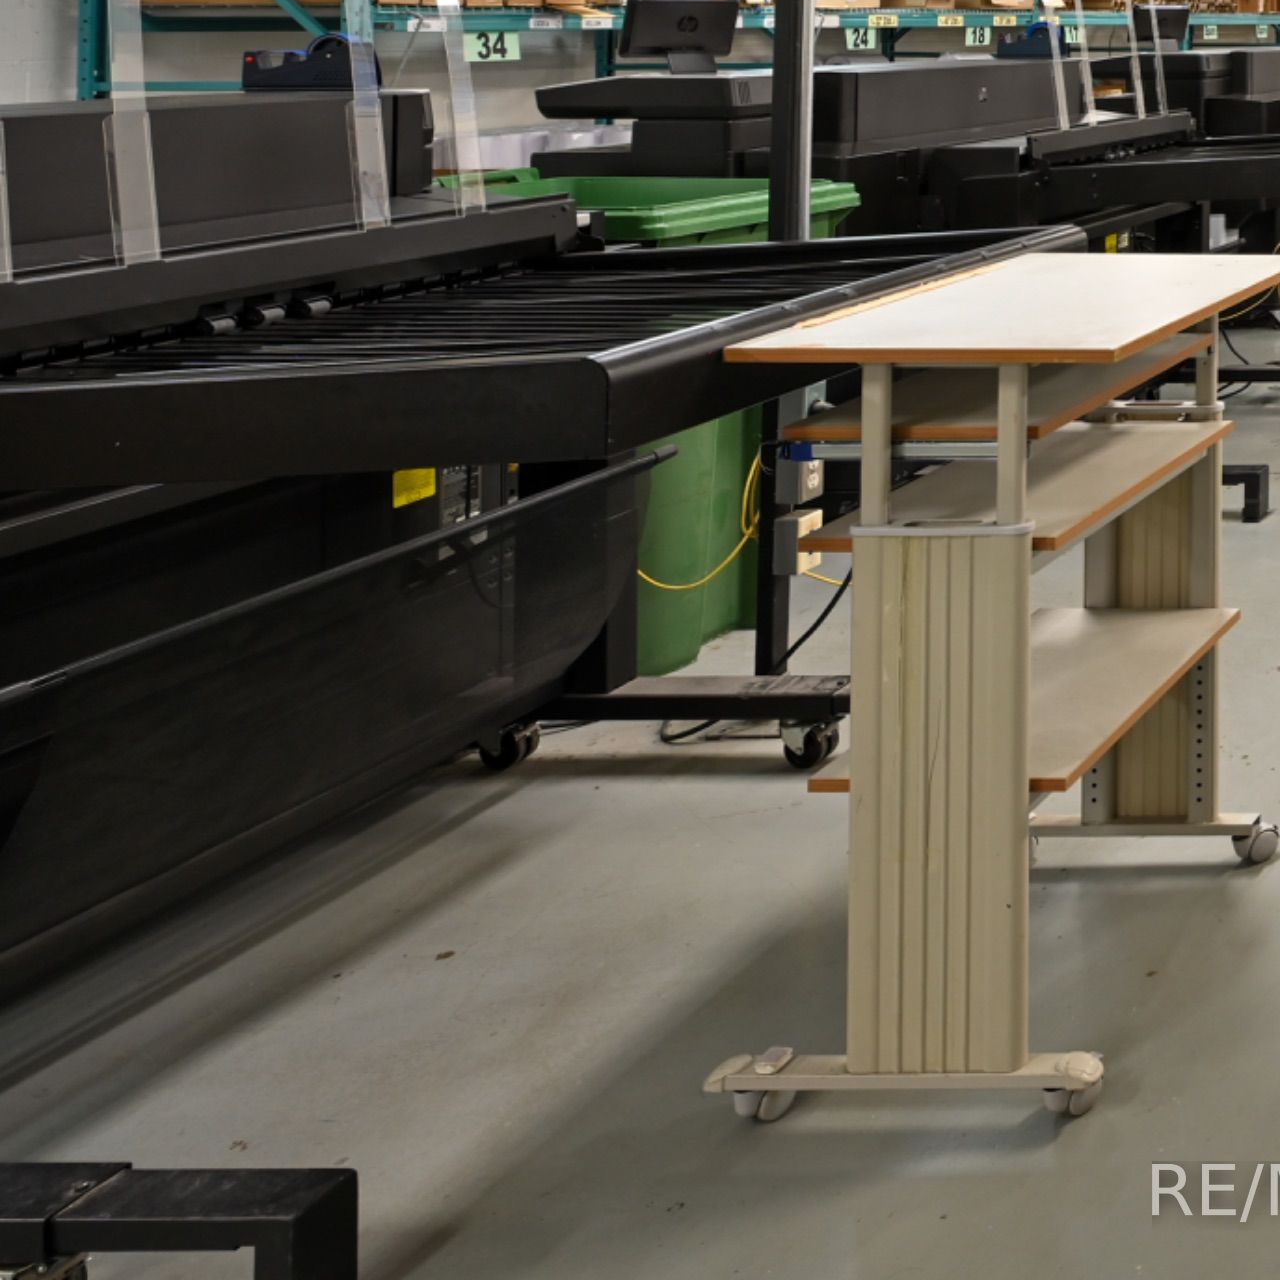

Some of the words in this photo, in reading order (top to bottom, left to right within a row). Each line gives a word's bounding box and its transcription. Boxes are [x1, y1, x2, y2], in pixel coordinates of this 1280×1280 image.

[476, 31, 507, 60] 34
[852, 28, 868, 48] 24
[971, 27, 985, 44] 18
